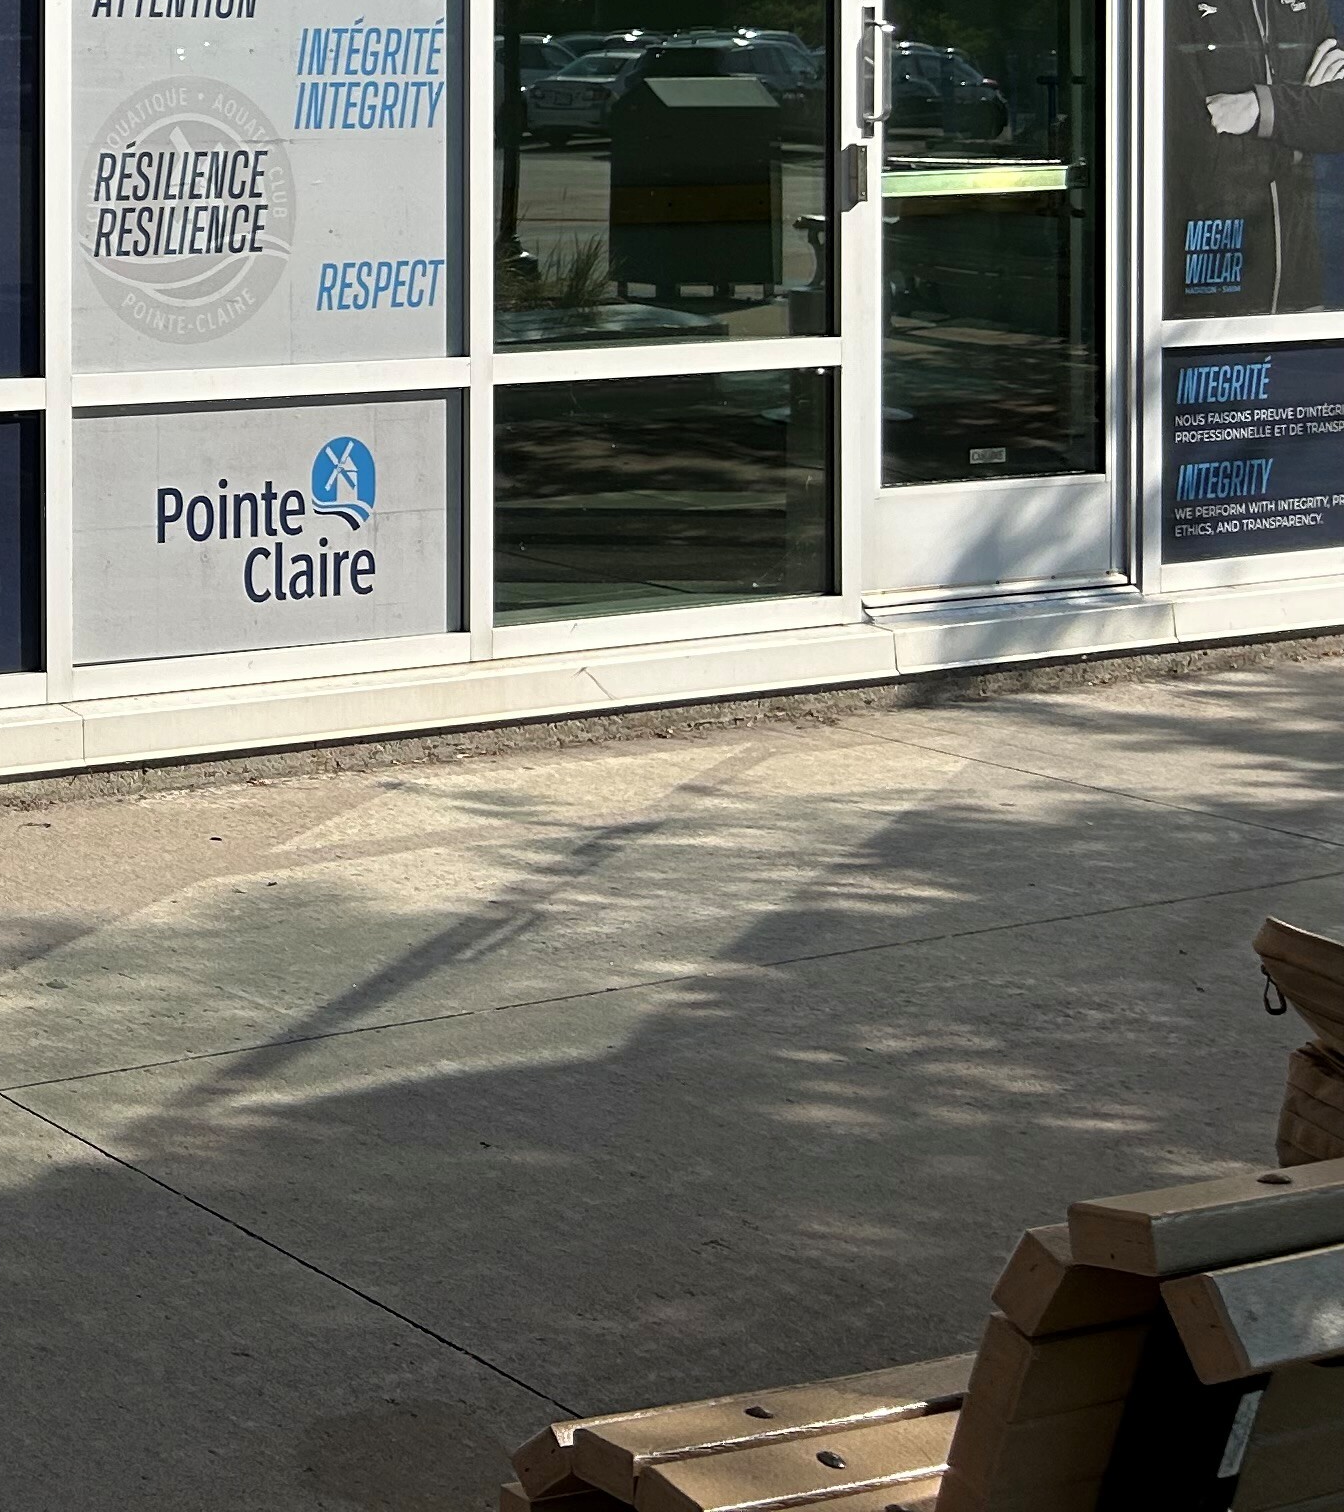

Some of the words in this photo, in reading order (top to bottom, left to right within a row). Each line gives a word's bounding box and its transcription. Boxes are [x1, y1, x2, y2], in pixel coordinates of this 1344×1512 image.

[296, 16, 445, 76] INTÉGRITÉ
[294, 81, 444, 130] INTEGRITY
[93, 140, 268, 202] RÉSILIENCE
[269, 166, 288, 219] CLUB
[93, 204, 268, 257] RESILIENCE
[1185, 219, 1244, 251] MEGAN
[316, 259, 445, 311] RESPECT
[121, 288, 256, 334] POINTE-CLAIRE
[1175, 413, 1205, 426] NOUS
[1207, 410, 1251, 423] FAISONS
[1254, 407, 1294, 421] PREUVE
[1175, 425, 1271, 443] PROFESSIONNELLE
[1274, 424, 1286, 436] ET
[1289, 423, 1303, 435] DE
[1177, 458, 1273, 501] INTEGRITY
[157, 478, 306, 544] Pointe
[1174, 507, 1192, 519] WE
[1195, 502, 1245, 517] PERFORM
[1247, 500, 1275, 513] WITH
[1215, 520, 1239, 533] AND
[1241, 512, 1323, 531] TRANSPARENCY.
[244, 536, 376, 604] Claire
